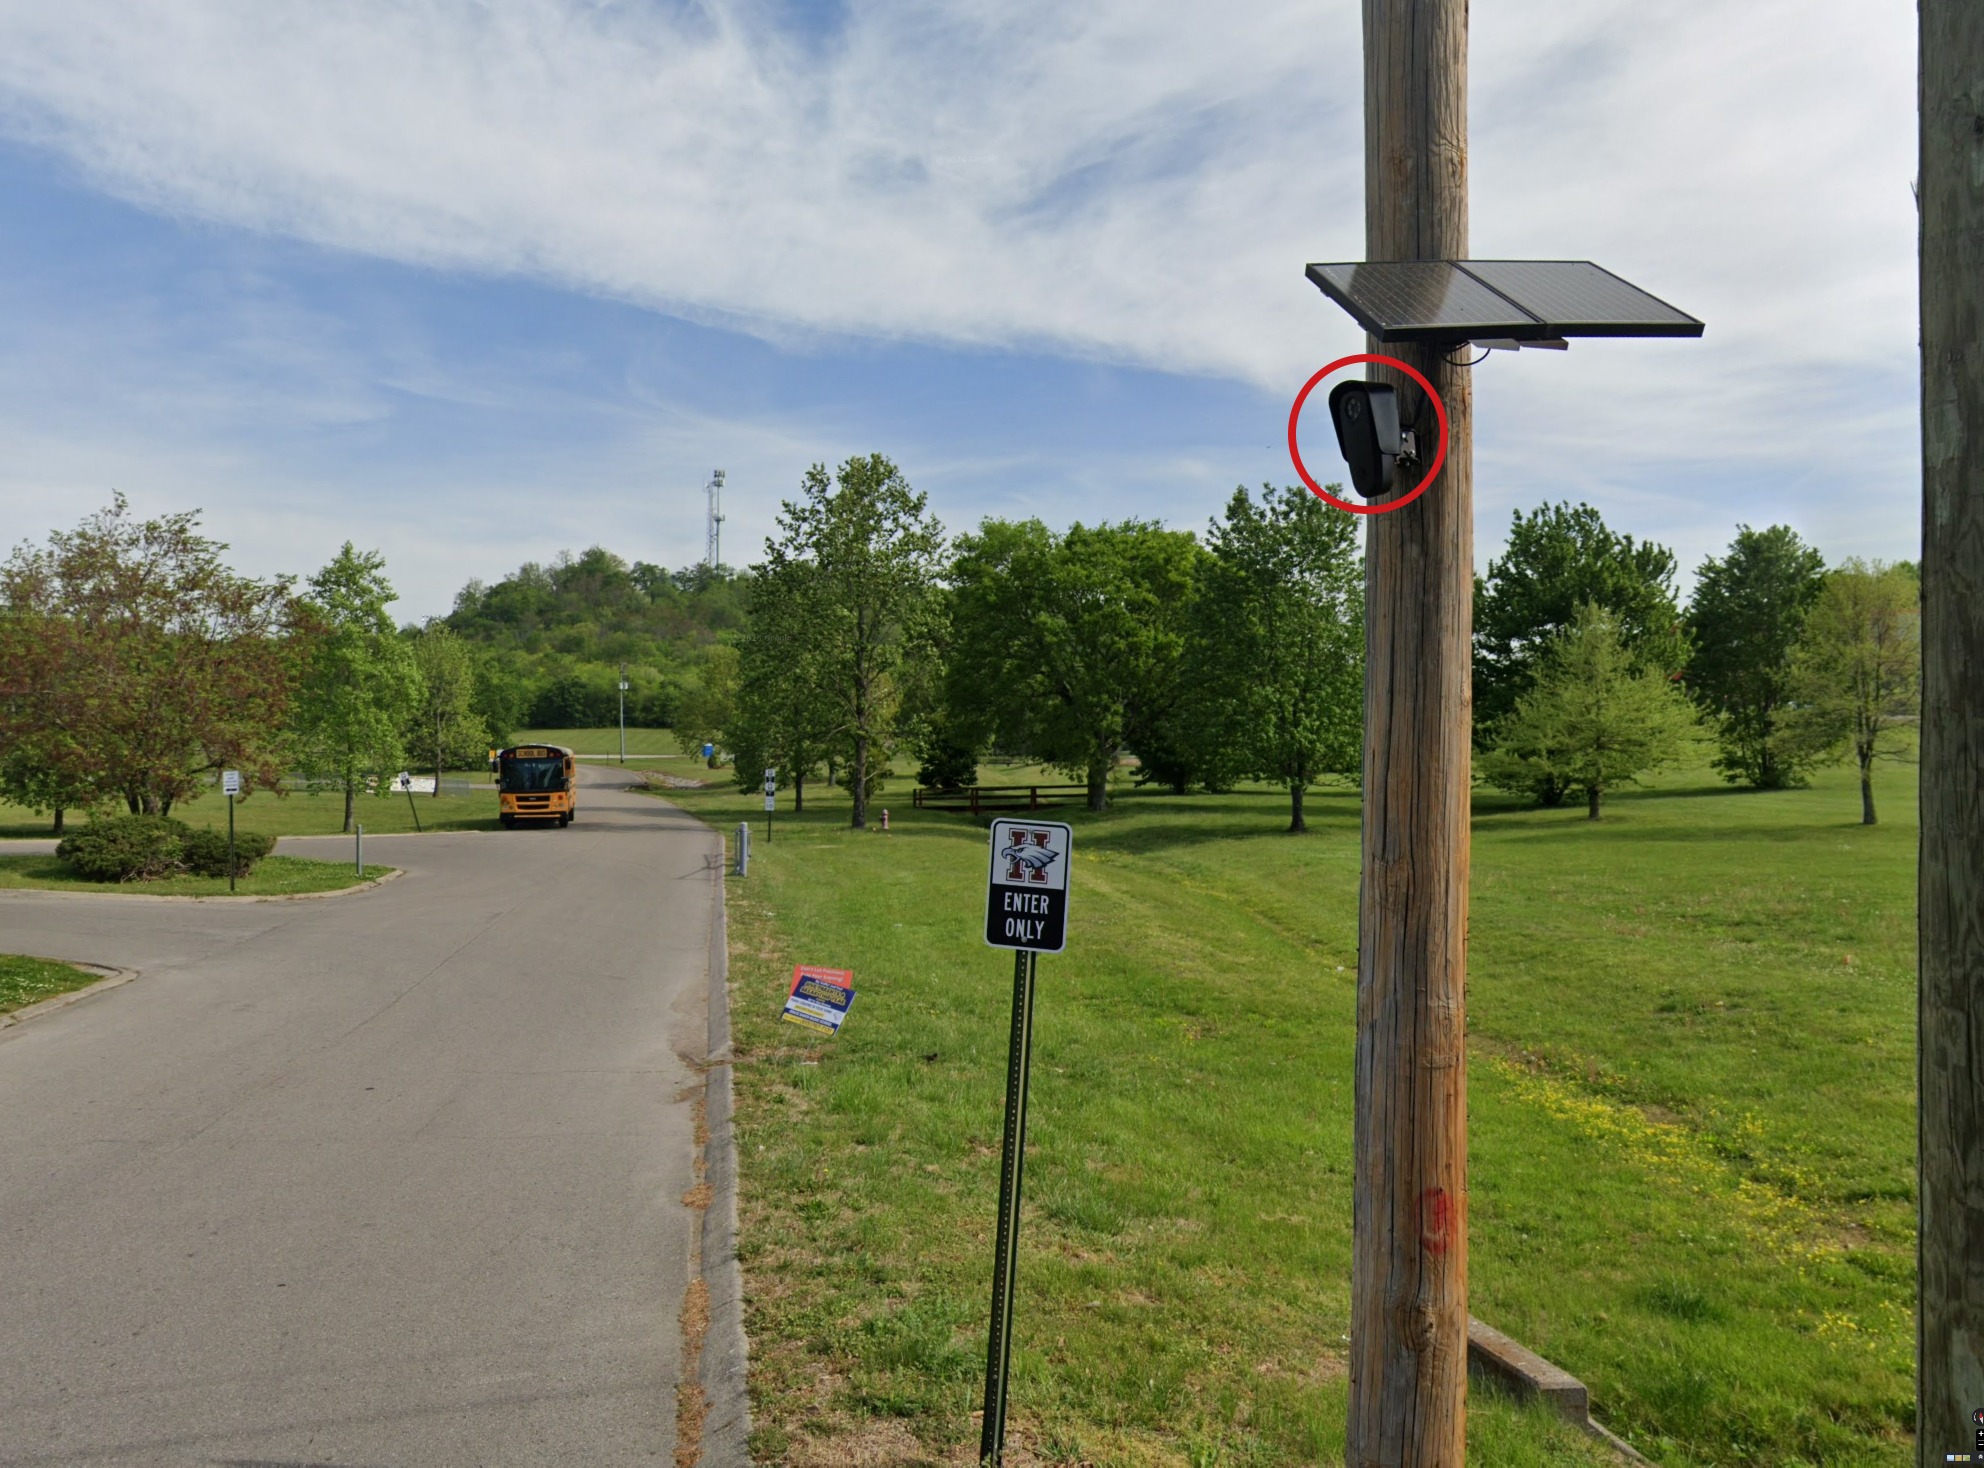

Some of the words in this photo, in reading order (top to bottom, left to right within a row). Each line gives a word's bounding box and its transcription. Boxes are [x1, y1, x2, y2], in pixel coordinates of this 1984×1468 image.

[537, 749, 546, 757] BUS
[1004, 892, 1050, 915] ENTER
[1005, 918, 1045, 940] ONLY
